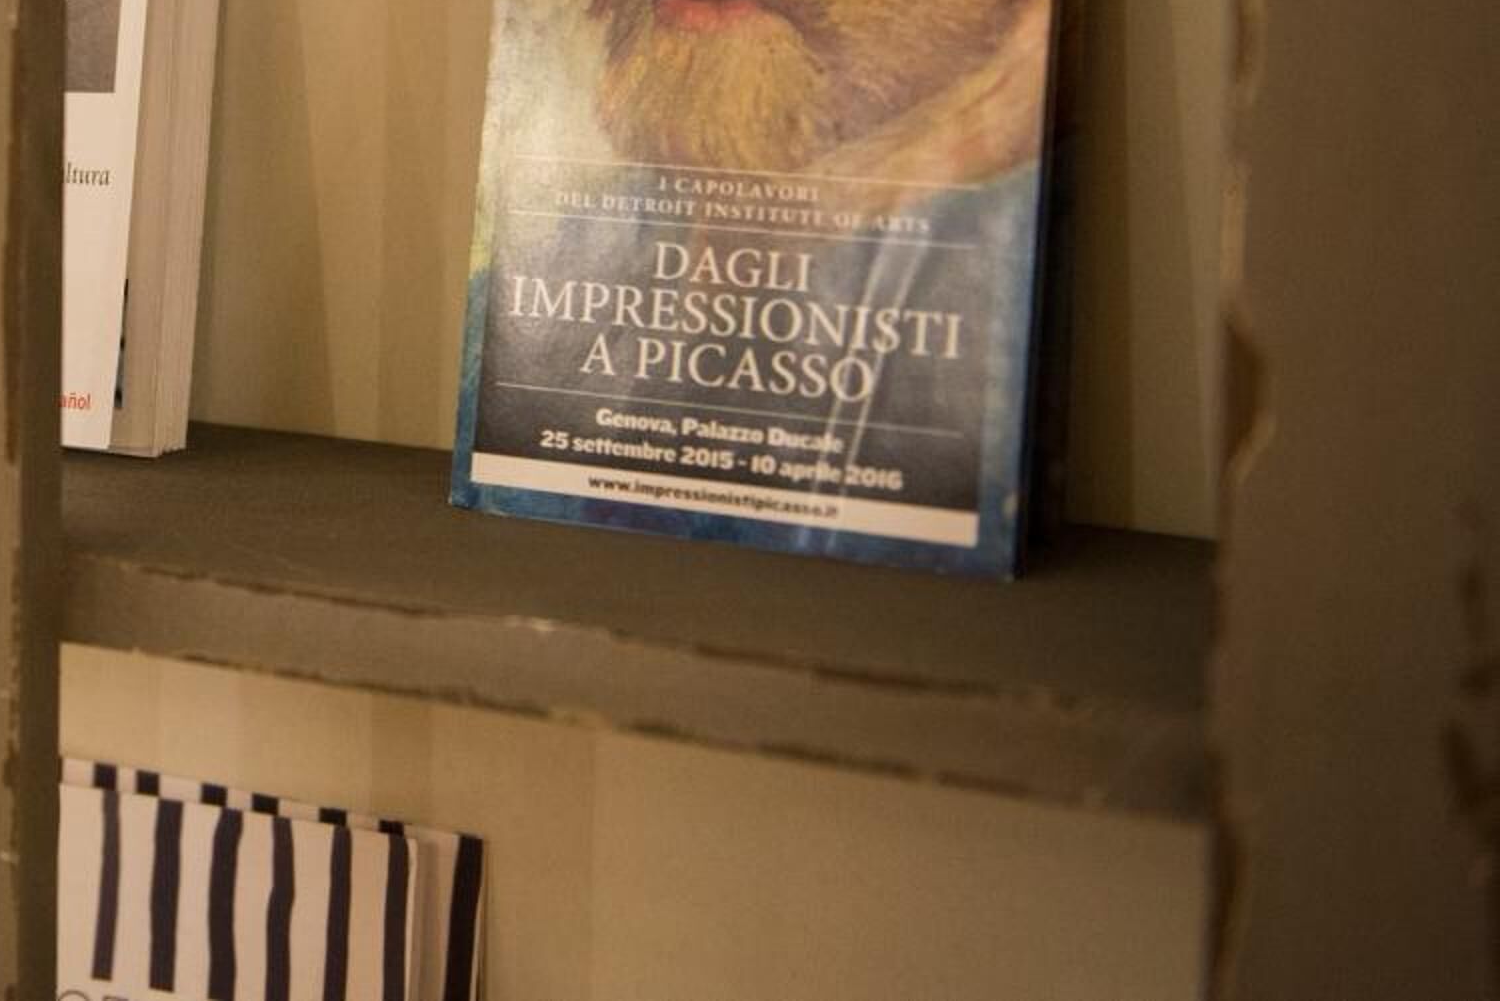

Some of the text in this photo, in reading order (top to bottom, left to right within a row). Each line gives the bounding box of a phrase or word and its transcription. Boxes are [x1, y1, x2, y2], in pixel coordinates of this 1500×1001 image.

[66, 161, 110, 186] ltura
[658, 176, 820, 202] I CAPOLAVORI
[555, 190, 932, 235] DEL DETROIT INSTITUTE OF ARTS
[654, 241, 813, 293] DAGLI
[508, 275, 963, 360] IMPRESSIONISTI
[580, 332, 874, 402] A PICASSO
[596, 407, 844, 455] Genova, Palazzo Ducale
[540, 429, 568, 451] 25
[570, 434, 676, 464] settembre
[680, 447, 734, 471] 2015
[751, 454, 777, 478] 10
[779, 459, 843, 488] aprile
[845, 467, 904, 491] 2016
[589, 476, 838, 518] www.impressionistipicasso.it
